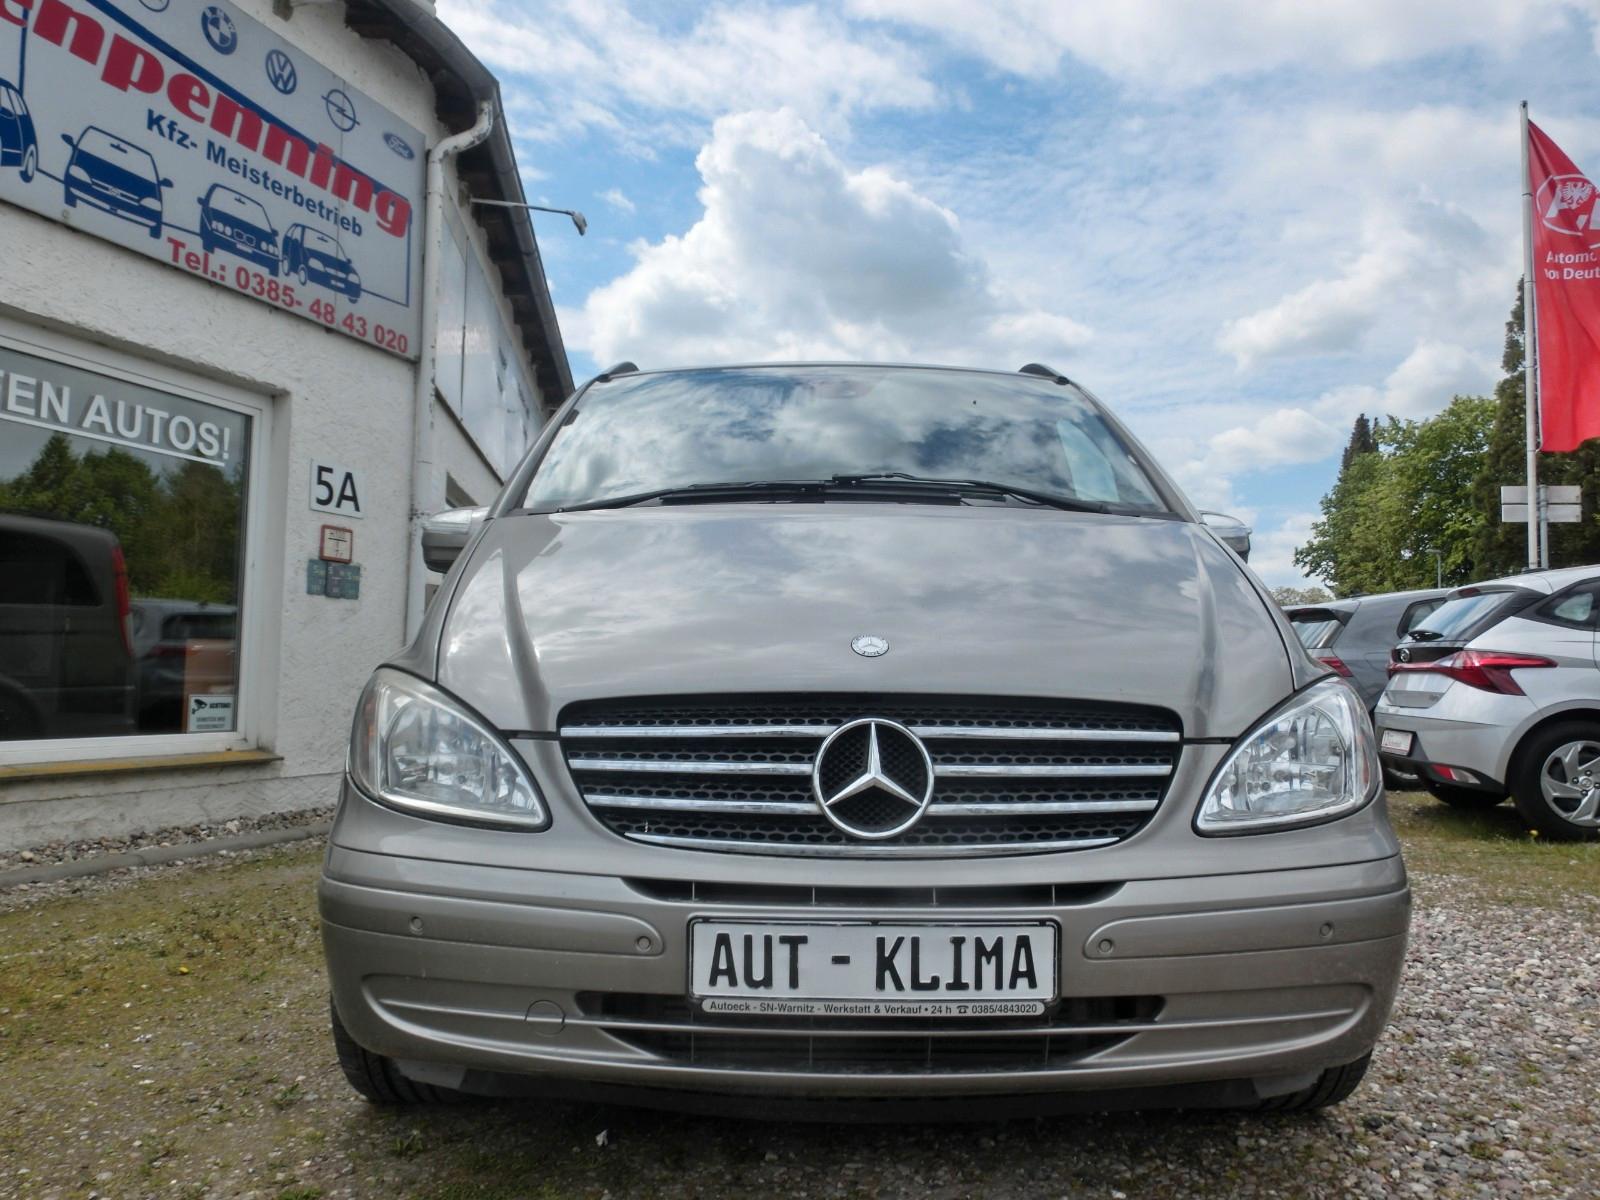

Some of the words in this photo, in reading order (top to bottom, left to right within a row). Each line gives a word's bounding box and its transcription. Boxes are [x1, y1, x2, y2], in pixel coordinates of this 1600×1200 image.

[147, 108, 197, 149] Kfz-
[206, 140, 363, 236] Meisterbetrieb
[167, 237, 226, 282] Tel.:
[309, 298, 336, 325] 48
[342, 312, 367, 338] 43
[374, 324, 408, 353] 020
[0, 369, 70, 423] EN
[82, 394, 230, 460] AUTOS!
[316, 465, 360, 512] 5A
[708, 932, 808, 989] AUT
[875, 935, 1038, 991] KLIMA
[710, 1001, 750, 1012] Autoeck
[760, 1003, 815, 1013] SN-Warnitz
[824, 1003, 871, 1014] Werkstatt
[874, 1004, 881, 1014] &
[884, 1004, 921, 1015] Verkauf
[931, 1005, 943, 1015] 24
[946, 1005, 952, 1014] h
[971, 1003, 1038, 1015] 0385/4843020
